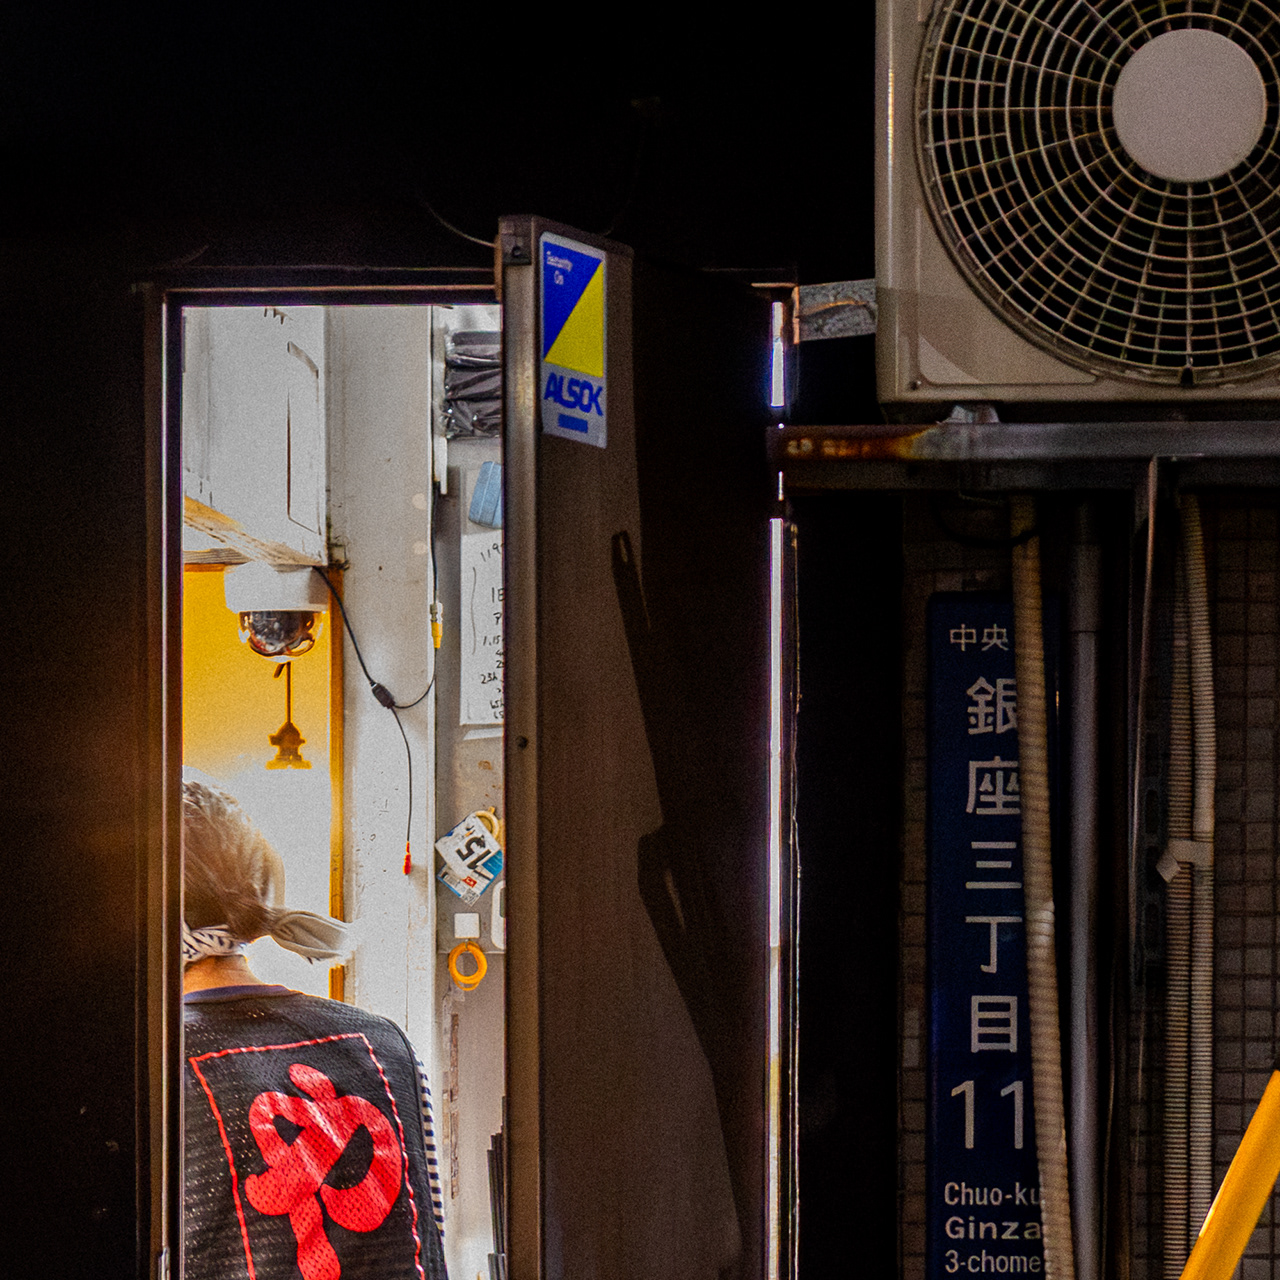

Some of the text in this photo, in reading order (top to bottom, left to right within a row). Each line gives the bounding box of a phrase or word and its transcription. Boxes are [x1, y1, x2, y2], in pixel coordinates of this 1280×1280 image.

[544, 372, 603, 417] ALSOK
[949, 623, 1010, 652] 中央
[951, 1080, 1024, 1150] 11
[943, 1181, 1042, 1206] Chuo-ku
[945, 1216, 1042, 1240] Ginza
[944, 1249, 1042, 1273] 3-chome
